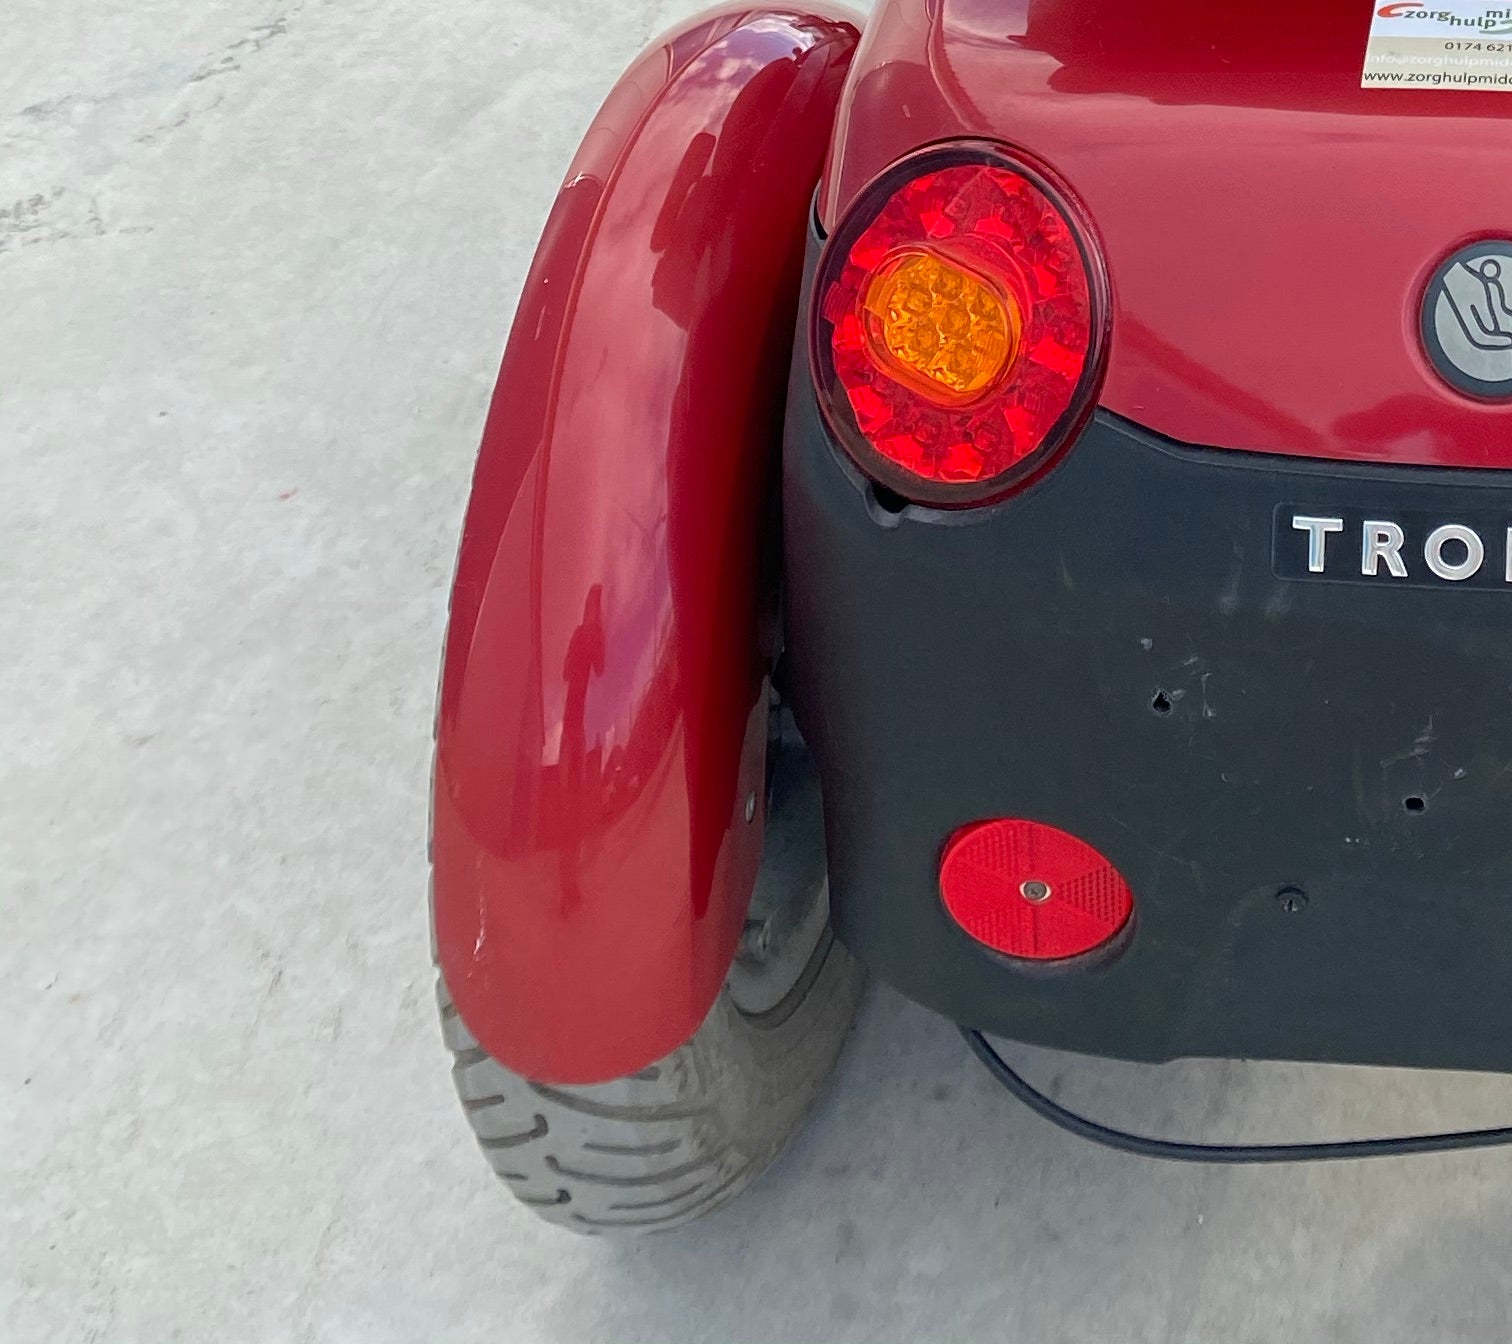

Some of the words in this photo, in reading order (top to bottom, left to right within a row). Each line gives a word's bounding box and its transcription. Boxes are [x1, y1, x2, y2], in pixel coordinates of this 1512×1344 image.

[1402, 8, 1451, 22] zorg
[1450, 15, 1496, 30] hulp
[1444, 41, 1482, 52] 0174
